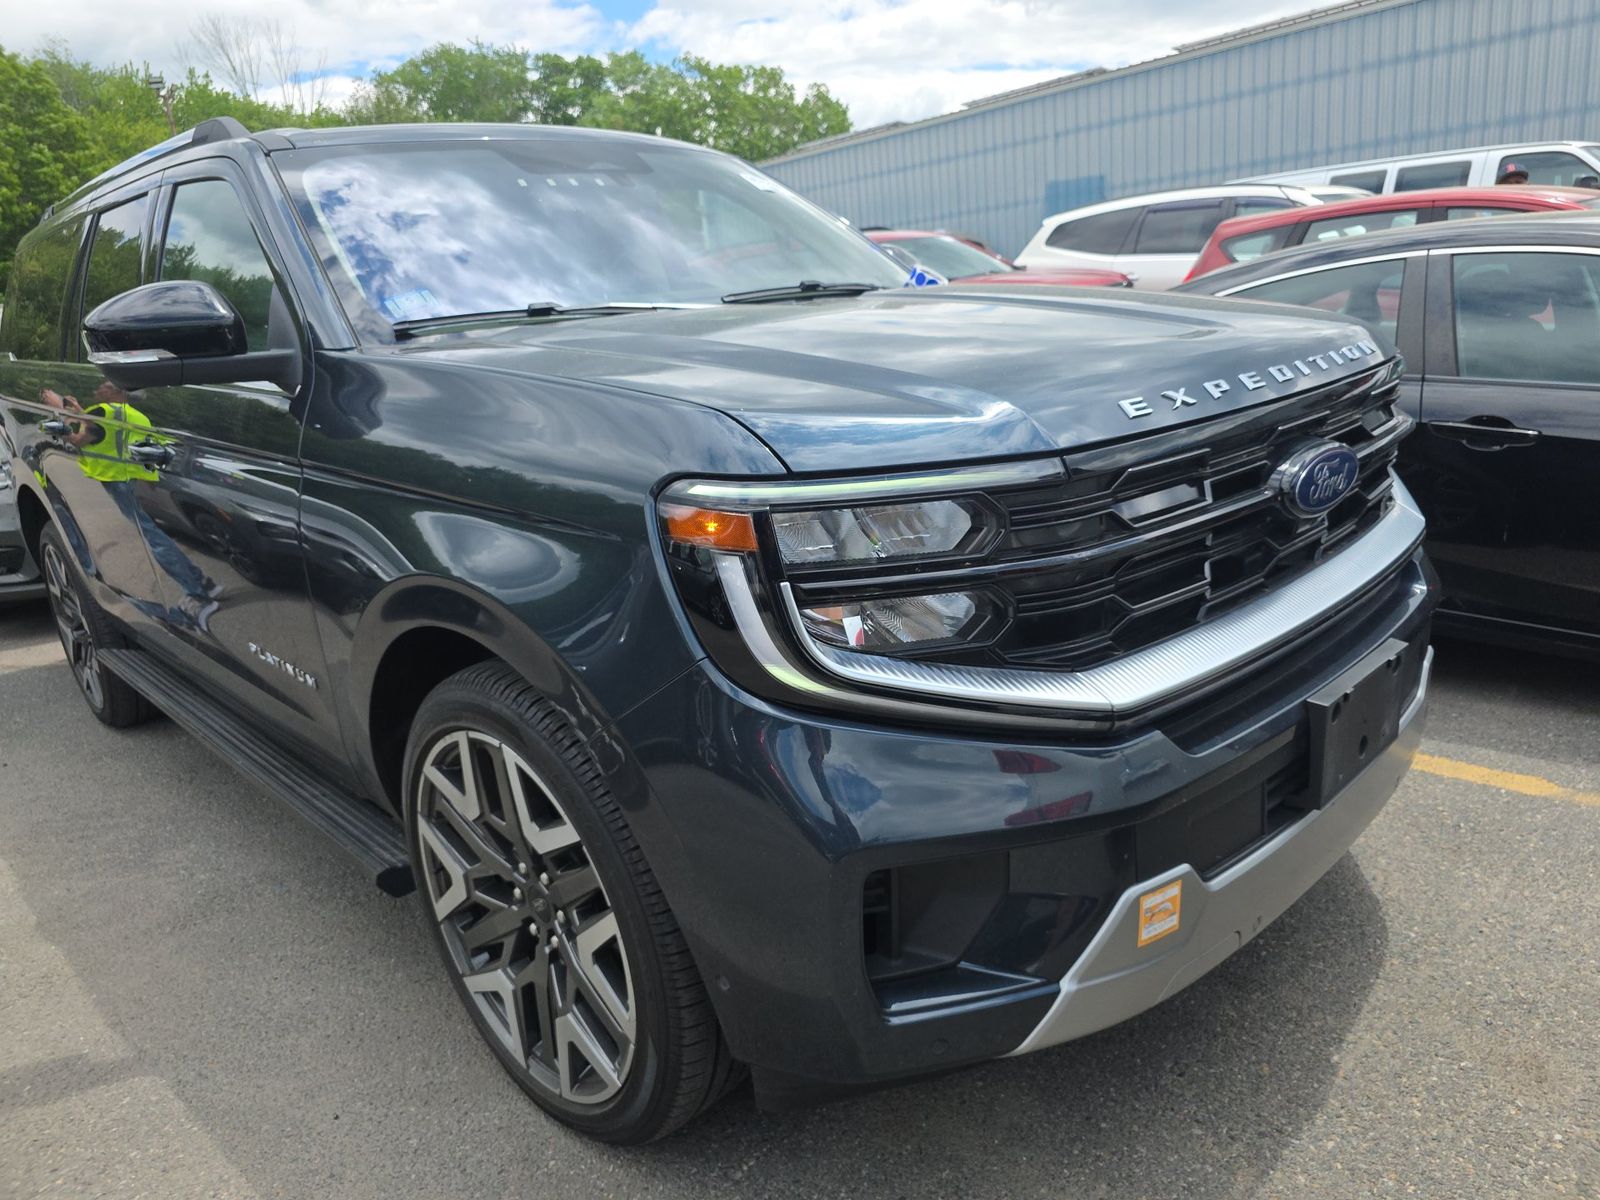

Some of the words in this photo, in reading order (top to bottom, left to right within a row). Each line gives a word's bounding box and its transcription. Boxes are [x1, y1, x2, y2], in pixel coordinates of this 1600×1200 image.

[1118, 340, 1377, 418] EXPEDITION
[1308, 456, 1351, 505] Ford
[248, 641, 319, 689] PLATINUM
